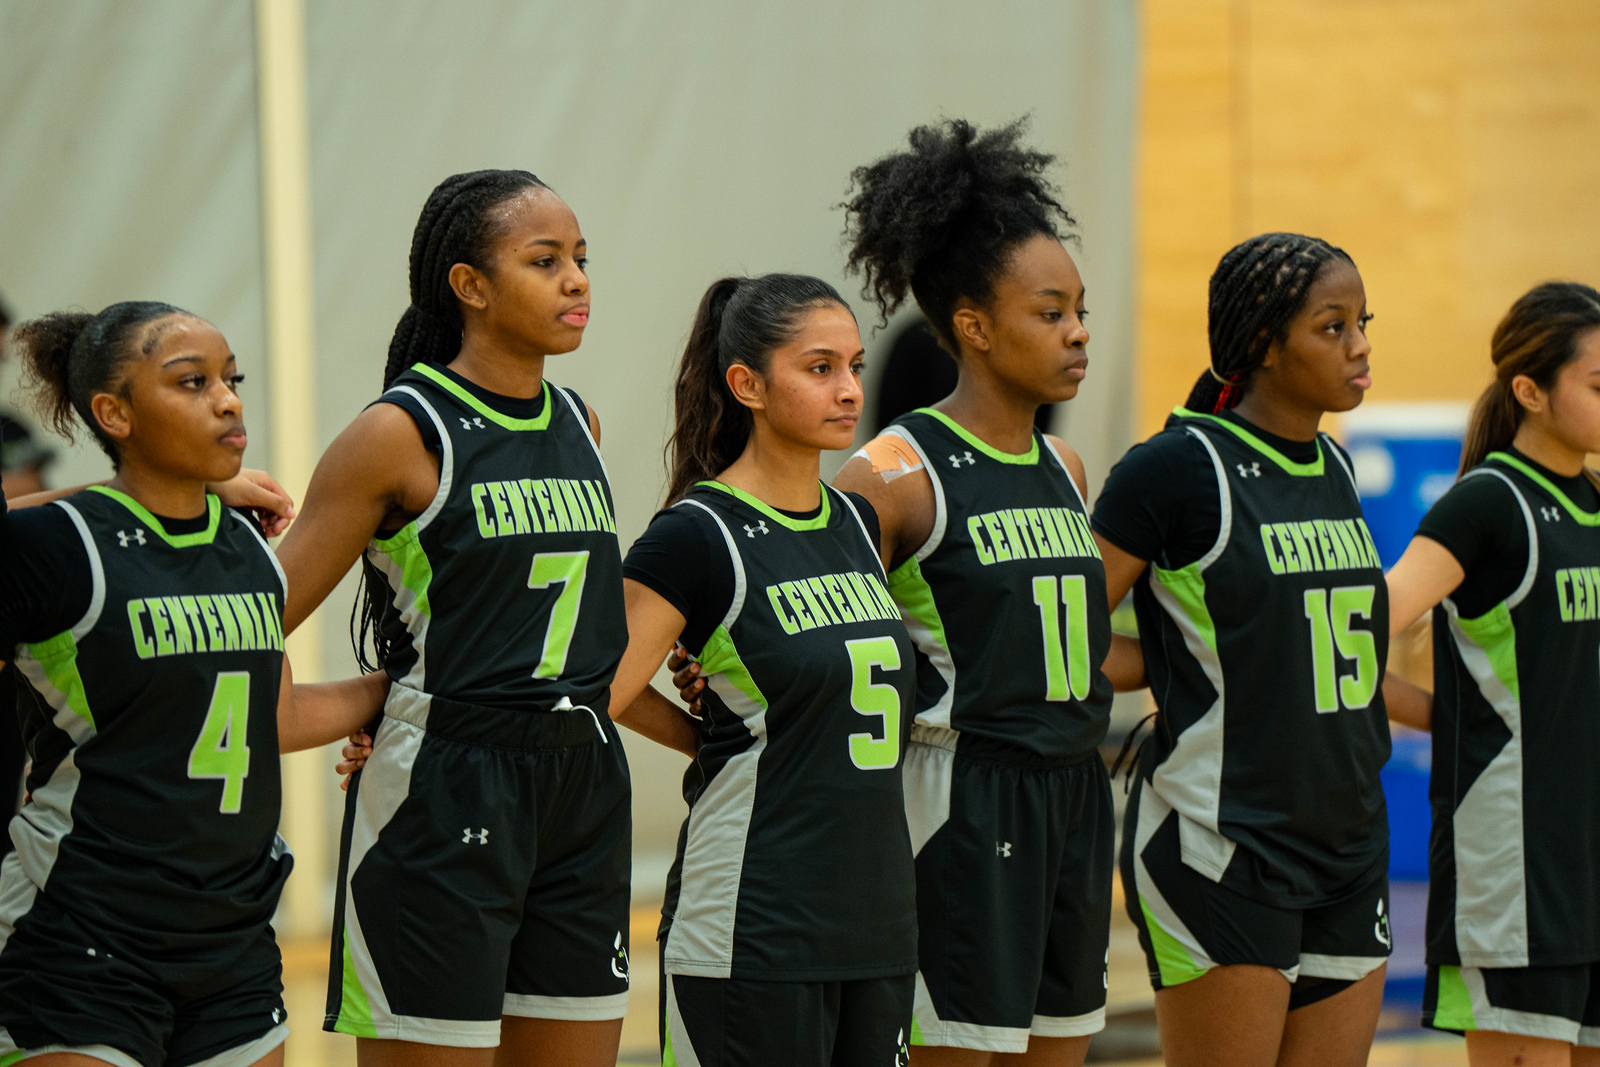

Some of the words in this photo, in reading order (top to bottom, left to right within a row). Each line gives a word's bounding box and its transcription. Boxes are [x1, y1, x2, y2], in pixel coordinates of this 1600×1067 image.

[471, 478, 617, 539] CENTENNIAL
[1260, 517, 1382, 575] CENTENNIA
[527, 550, 590, 681] 7
[1032, 574, 1091, 702] 11
[1303, 585, 1378, 714] 15
[188, 671, 249, 814] 4
[845, 636, 901, 770] 5
